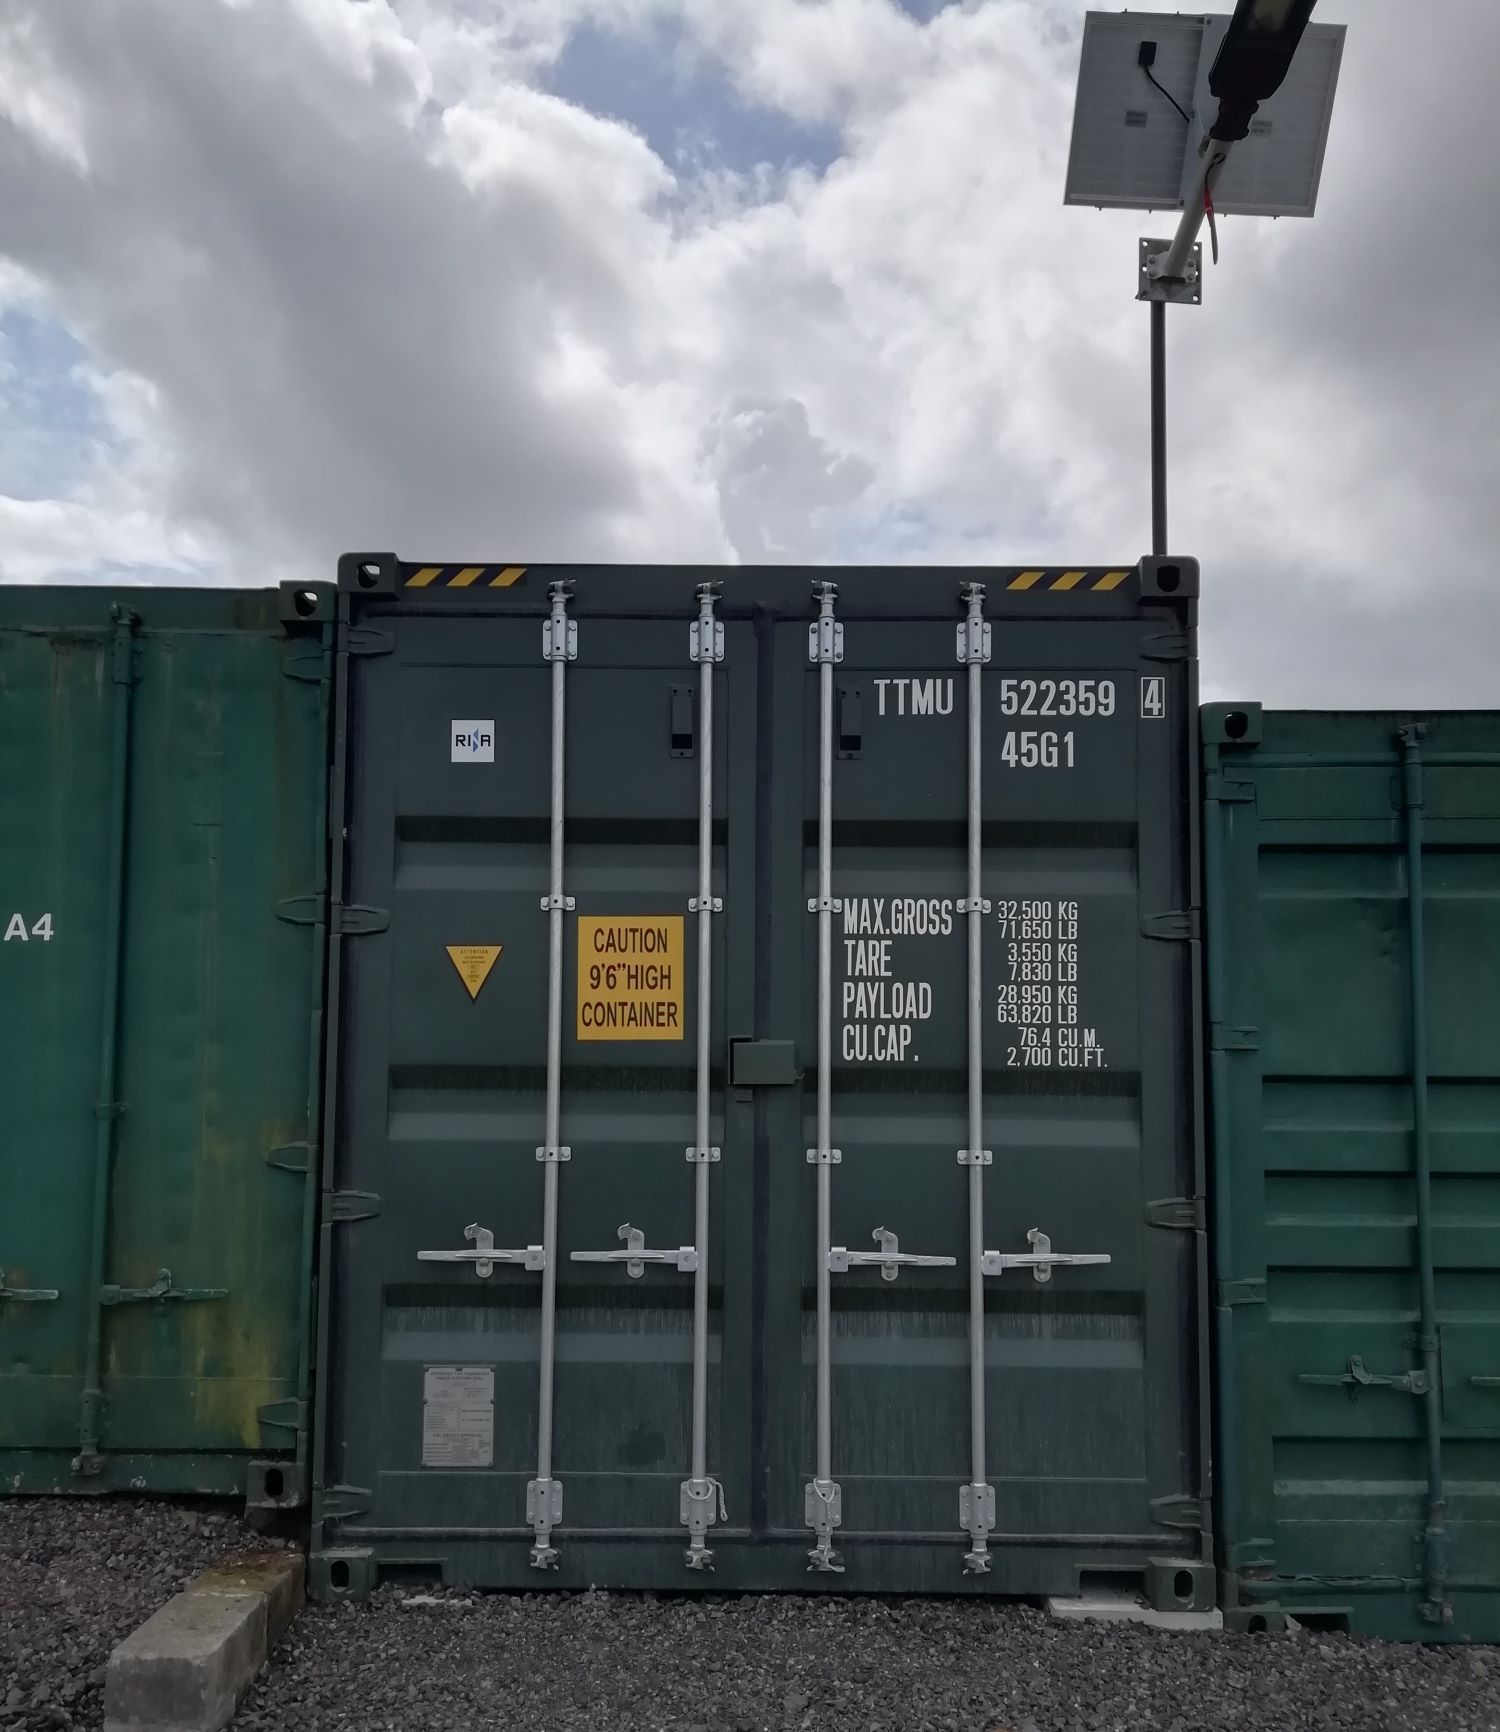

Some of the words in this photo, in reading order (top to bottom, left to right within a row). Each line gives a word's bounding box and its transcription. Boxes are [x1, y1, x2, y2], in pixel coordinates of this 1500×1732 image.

[873, 678, 954, 716] TTMU
[1000, 679, 1116, 716] 522359
[1144, 679, 1162, 716] 4
[1001, 731, 1075, 768] 45G1
[843, 898, 953, 935] MAX.GROSS
[998, 901, 1052, 920] 32,500
[1058, 901, 1078, 920] KG
[3, 913, 54, 941] A4
[1000, 920, 1052, 940] 71,650
[1058, 921, 1078, 940] LB
[593, 927, 668, 953] CAUTION
[844, 940, 893, 977] TARE
[1008, 943, 1052, 962] 3,550
[1058, 943, 1078, 962] KG
[1008, 962, 1052, 982] 7,830
[1058, 963, 1078, 982] LB
[843, 982, 932, 1019] PAYLOAD
[997, 985, 1052, 1005] 28,950
[1058, 985, 1078, 1004] KG
[581, 1001, 678, 1027] CONTAINER
[997, 1004, 1052, 1024] 63,820
[1058, 1005, 1078, 1024] LB
[1017, 1027, 1051, 1047] 76.4
[1058, 1028, 1101, 1048] CU.M.
[1007, 1047, 1052, 1067] 2,700
[1058, 1048, 1108, 1067] CU.FT.
